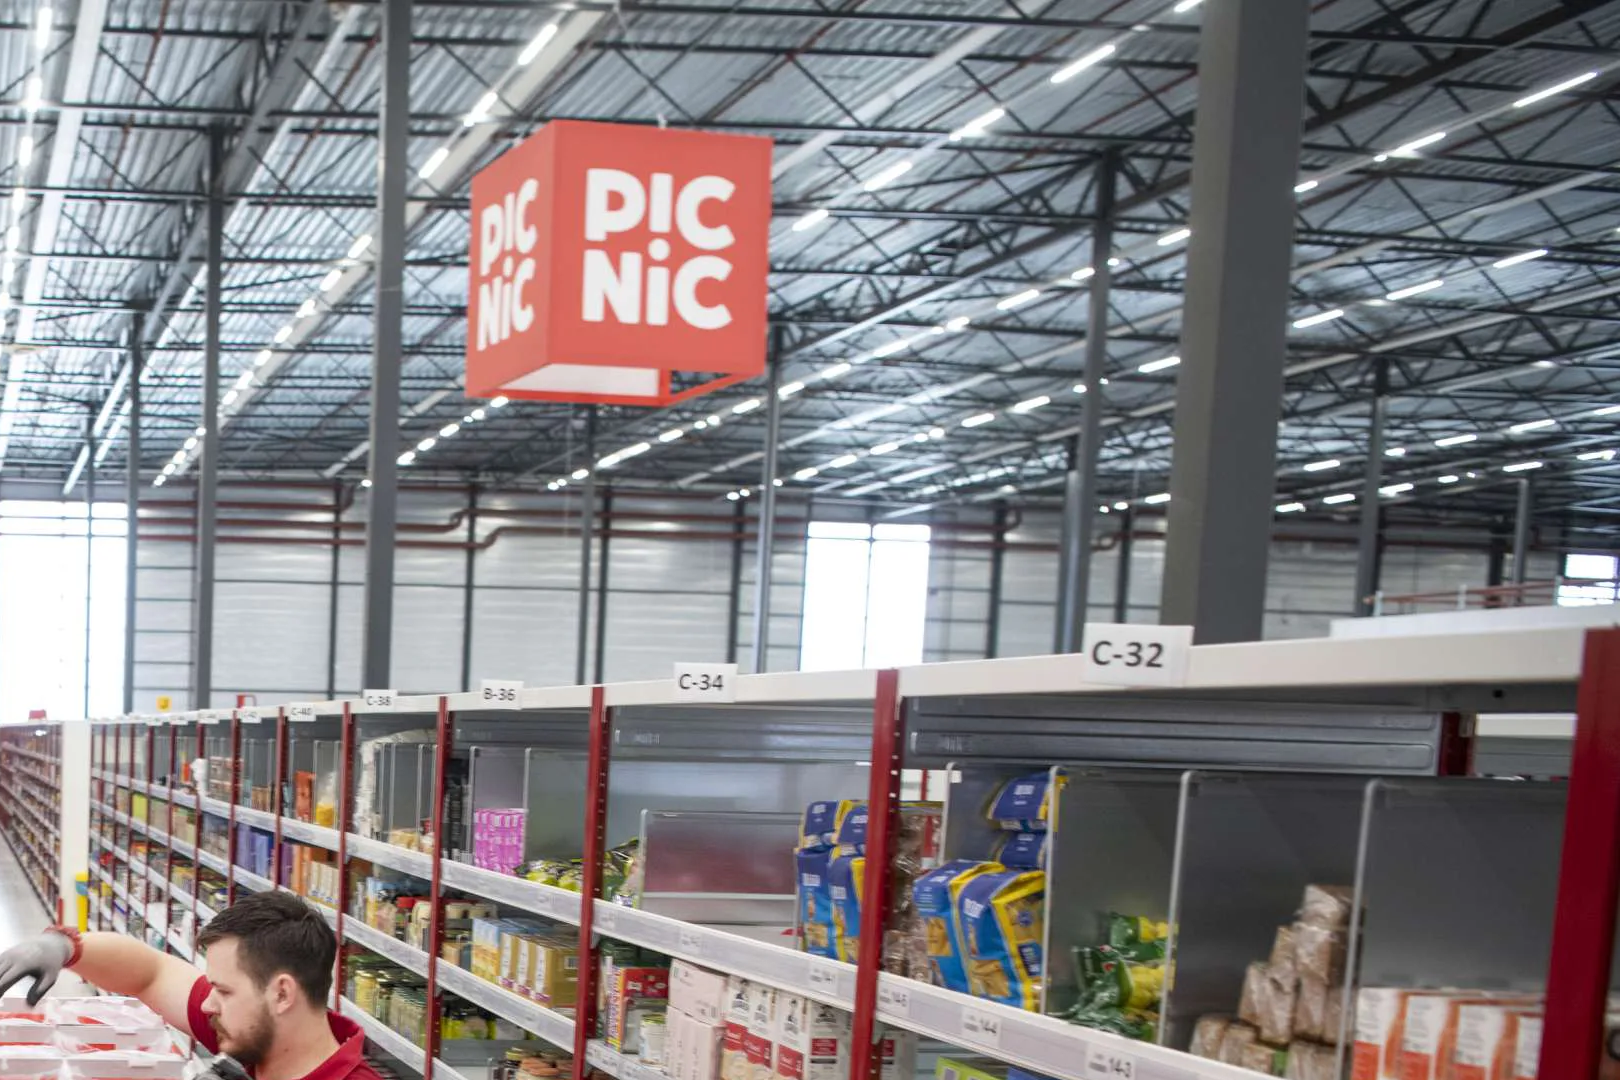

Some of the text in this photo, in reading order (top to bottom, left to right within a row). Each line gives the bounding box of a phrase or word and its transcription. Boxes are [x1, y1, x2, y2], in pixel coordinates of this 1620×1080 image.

[1091, 641, 1162, 668] C-32
[679, 674, 723, 691] C-34
[367, 696, 391, 706] C-38
[483, 688, 516, 701] B-36
[1108, 1058, 1131, 1078] 14-3
